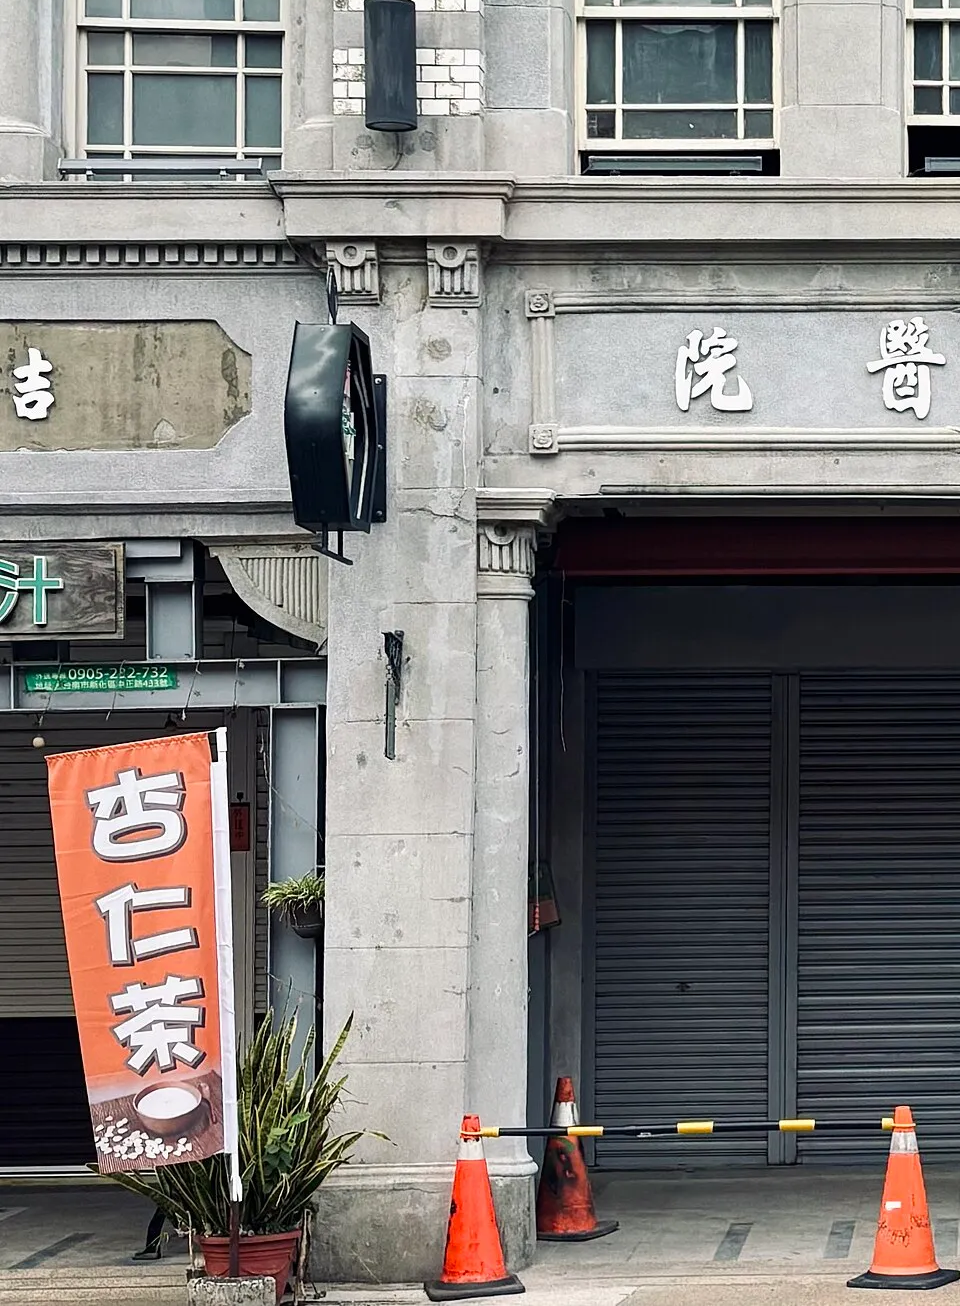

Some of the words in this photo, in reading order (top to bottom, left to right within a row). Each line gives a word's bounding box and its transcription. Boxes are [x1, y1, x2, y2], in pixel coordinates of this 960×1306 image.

[12, 347, 55, 421] 吉
[84, 766, 208, 1078] 杏仁茶
